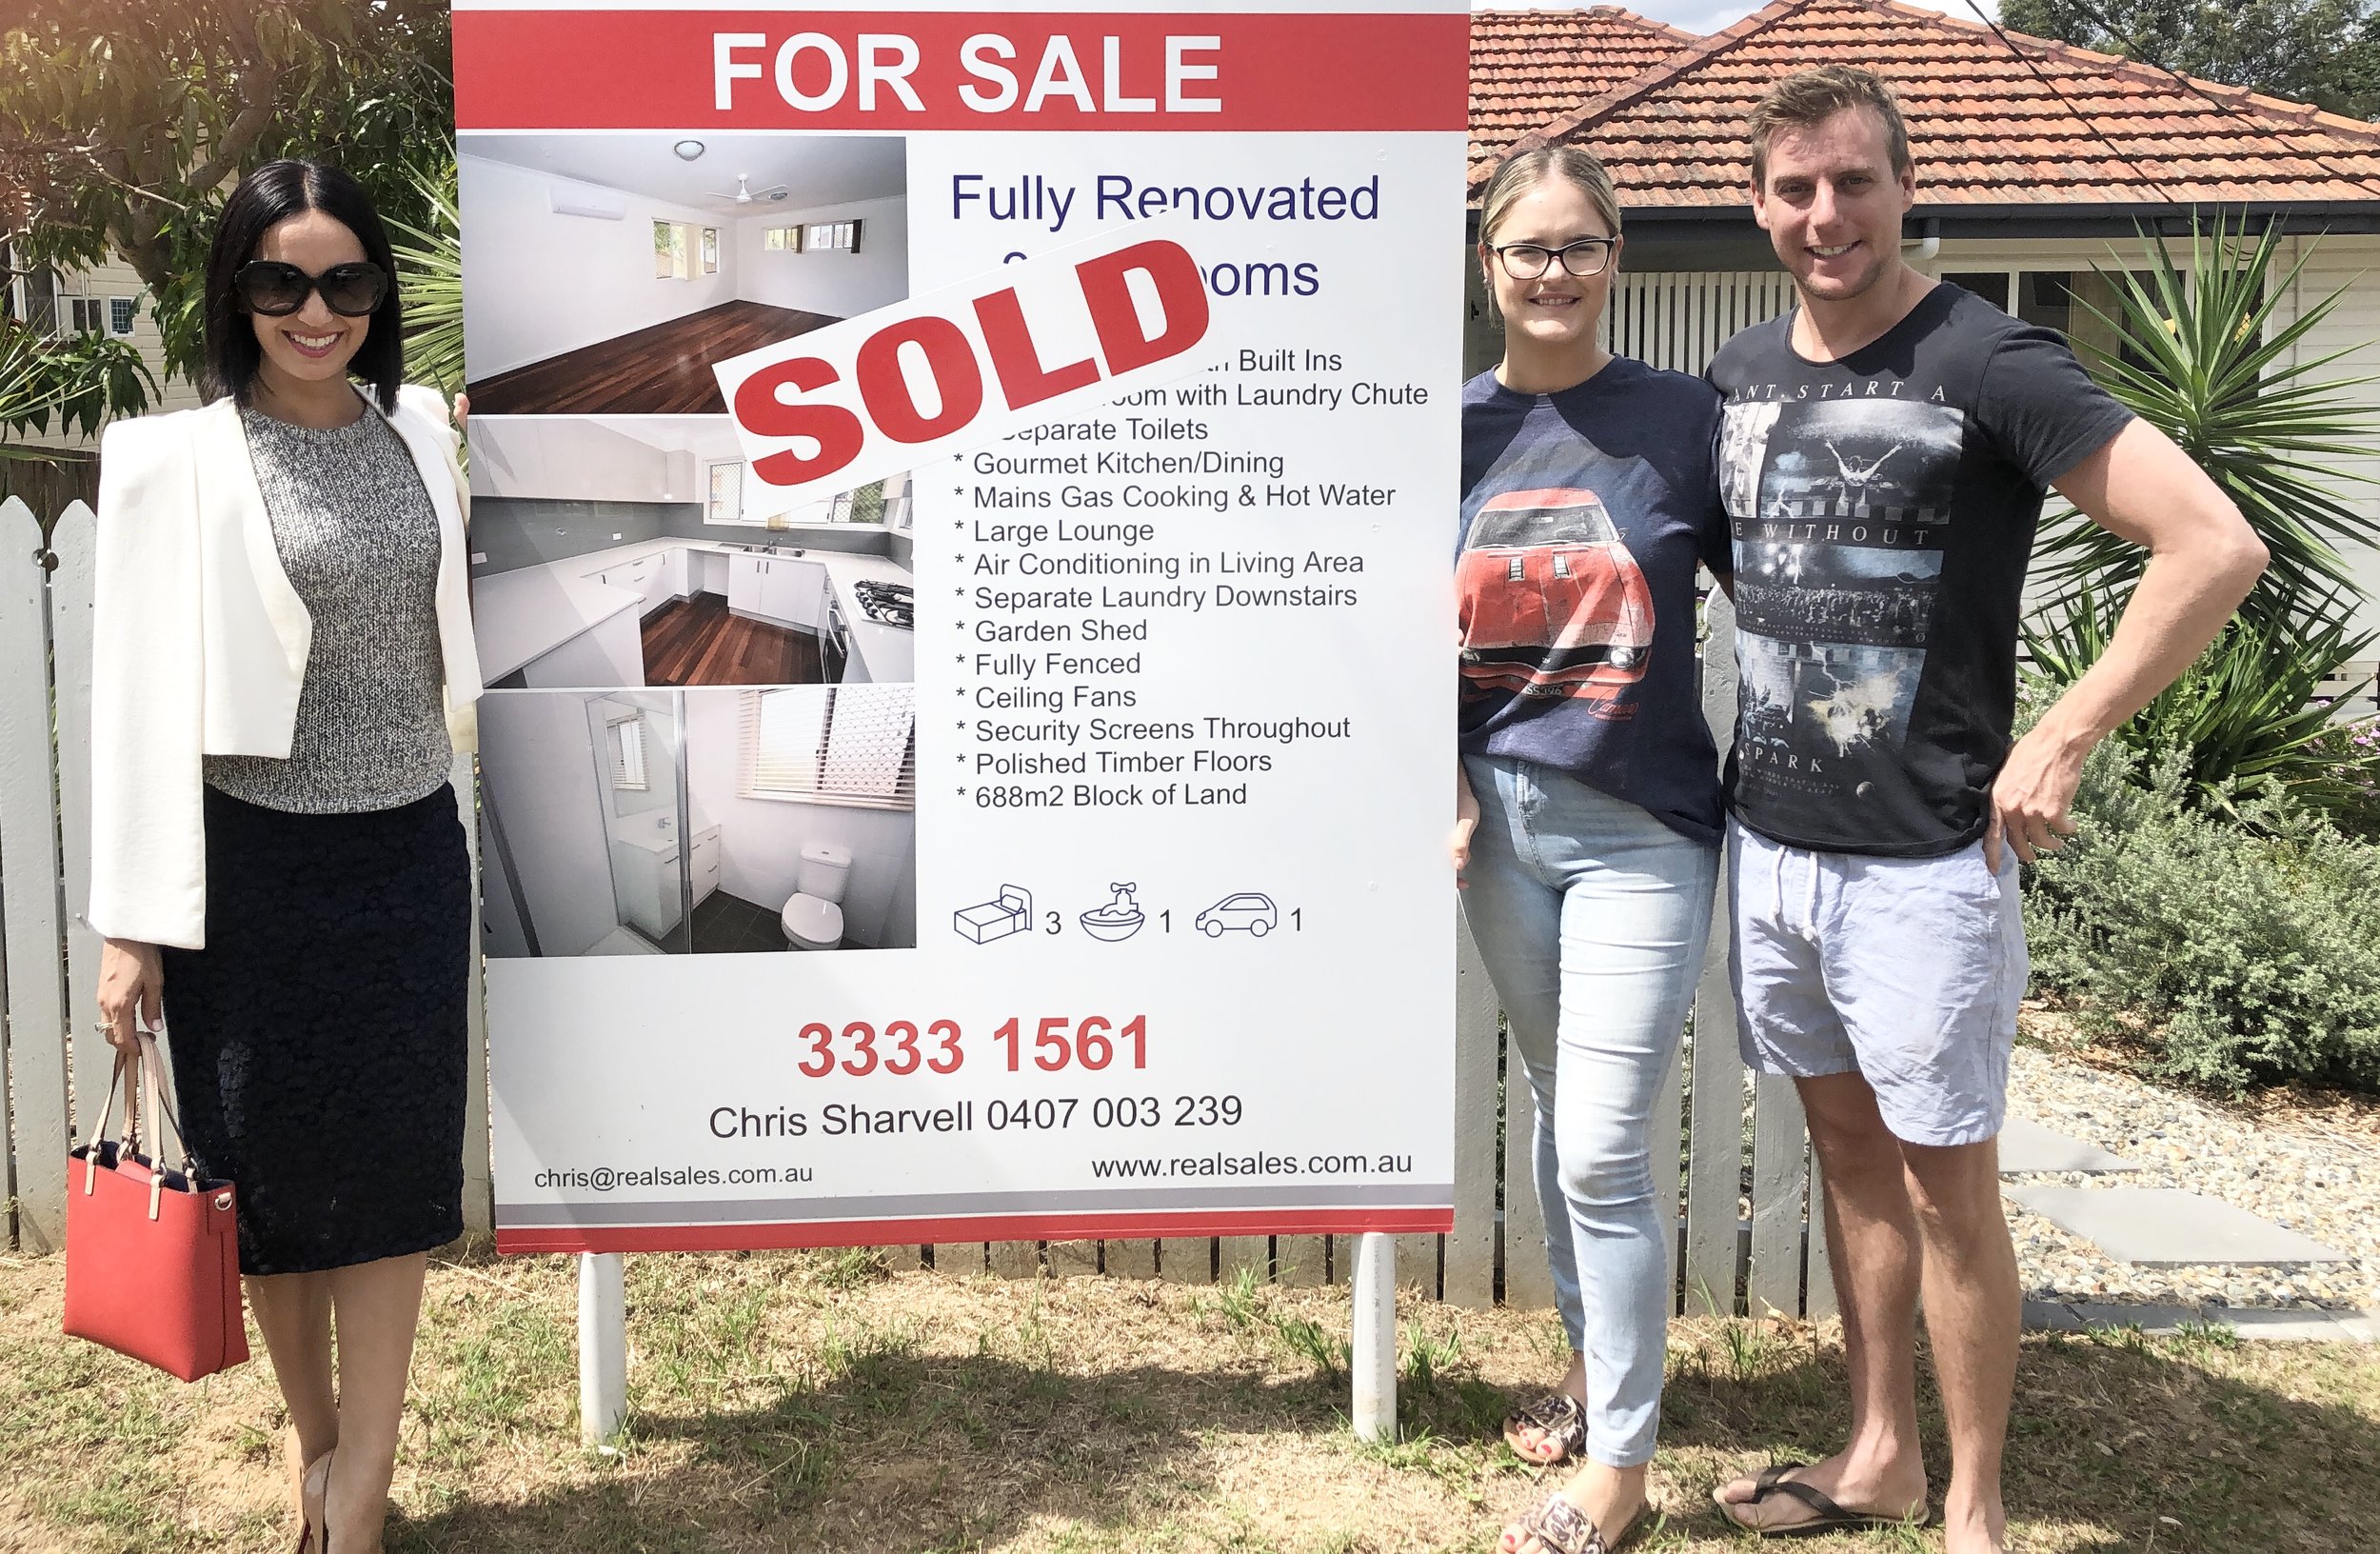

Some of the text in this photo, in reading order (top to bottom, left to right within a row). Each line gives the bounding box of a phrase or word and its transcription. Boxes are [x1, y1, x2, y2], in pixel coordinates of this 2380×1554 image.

[714, 32, 1222, 113] FOR SALE
[952, 174, 1379, 232] Fully Renovated
[734, 239, 1210, 487] SOLD
[1240, 349, 1296, 372] Built
[1305, 349, 1342, 372] Ins
[1176, 383, 1227, 407] with
[1238, 382, 1343, 411] Laundry
[1351, 382, 1429, 406] Chute
[1723, 380, 1947, 405] ANT START A
[1002, 417, 1209, 447] eparate Toilets
[973, 450, 1284, 479] Gourmet Kitchen/Dining
[974, 483, 1397, 513] Mains Gas Cooking & Hot Water
[975, 519, 1155, 548] Large Lounge
[1763, 524, 1929, 546] WITHOUT
[973, 550, 1364, 580] Air Conditioning in Living Area
[975, 584, 1358, 615] Separate Laundry Downstairs
[975, 618, 1147, 643] Garden Shed
[976, 651, 1140, 681] Fully Fenced
[975, 685, 1137, 714] Ceiling Fans
[976, 716, 1351, 747] Security Screens Throughout
[976, 749, 1273, 775] Polished Timber Floors
[1744, 742, 1823, 773] SPARK
[975, 782, 1247, 808] 688m2 Block of Land
[1045, 906, 1302, 936] 3 1 1
[798, 1015, 1151, 1078] 3333 1561
[709, 1094, 1242, 1139] Chris Sharvell 0407 003 239
[534, 1165, 813, 1192] chris@realsales.com.au
[1091, 1150, 1412, 1179] www.realsales.com.au
